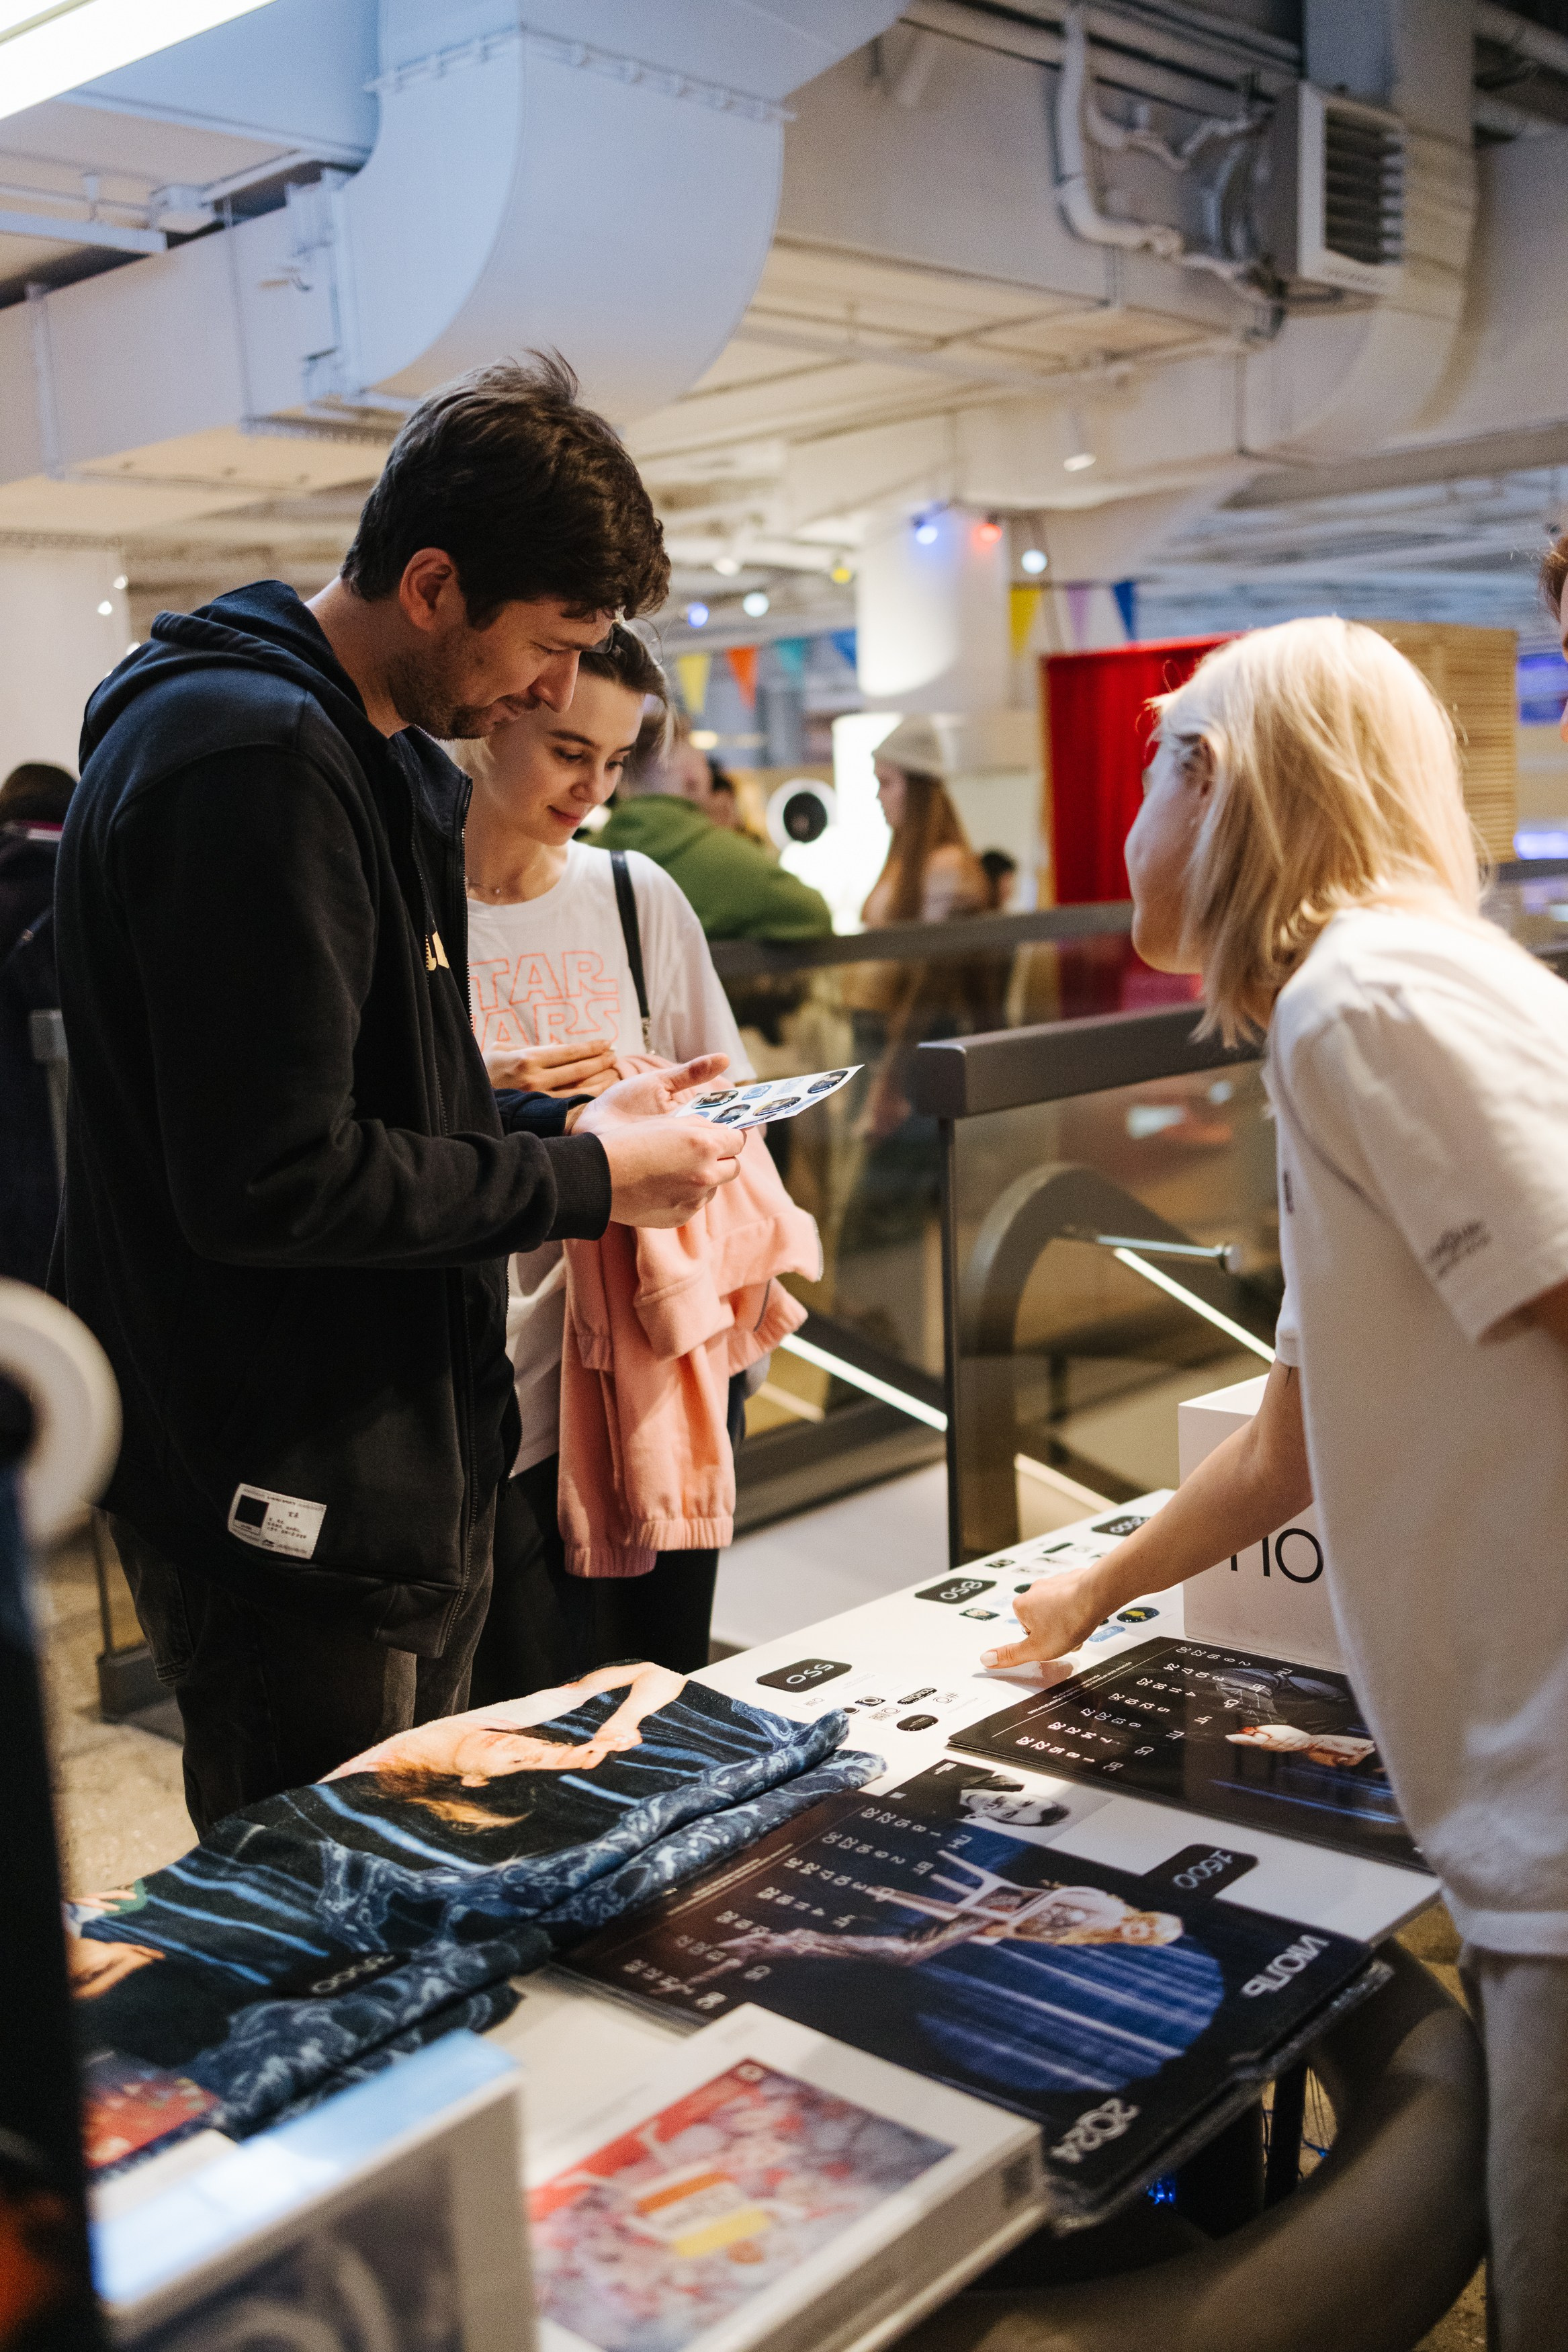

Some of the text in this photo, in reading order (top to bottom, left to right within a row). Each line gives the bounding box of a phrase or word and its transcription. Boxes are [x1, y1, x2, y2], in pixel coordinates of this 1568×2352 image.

[467, 950, 619, 1011] TAR
[472, 997, 621, 1054] ARS
[940, 1581, 983, 1599] 850
[1163, 1663, 1180, 1671] 24
[1181, 1667, 1194, 1675] 17
[786, 1664, 834, 1684] 550
[1136, 1677, 1153, 1687] 25
[1152, 1682, 1168, 1690] 18
[1108, 1693, 1125, 1701] 26
[1125, 1697, 1139, 1706] 19
[1139, 1702, 1156, 1710] 12
[1080, 1708, 1096, 1717] 27
[1094, 1712, 1112, 1720] 20
[1102, 1667, 1293, 1771] ПН ВТ СР ЧТ ПТ СБ ВС
[1047, 1722, 1066, 1730] 28
[1064, 1726, 1081, 1734] 21
[1016, 1736, 1035, 1745] 29
[1031, 1741, 1050, 1750] 22
[1172, 1849, 1233, 1889] 1600
[1241, 1933, 1330, 1999] ИЮЛЬ
[1050, 2097, 1140, 2164] 2024
